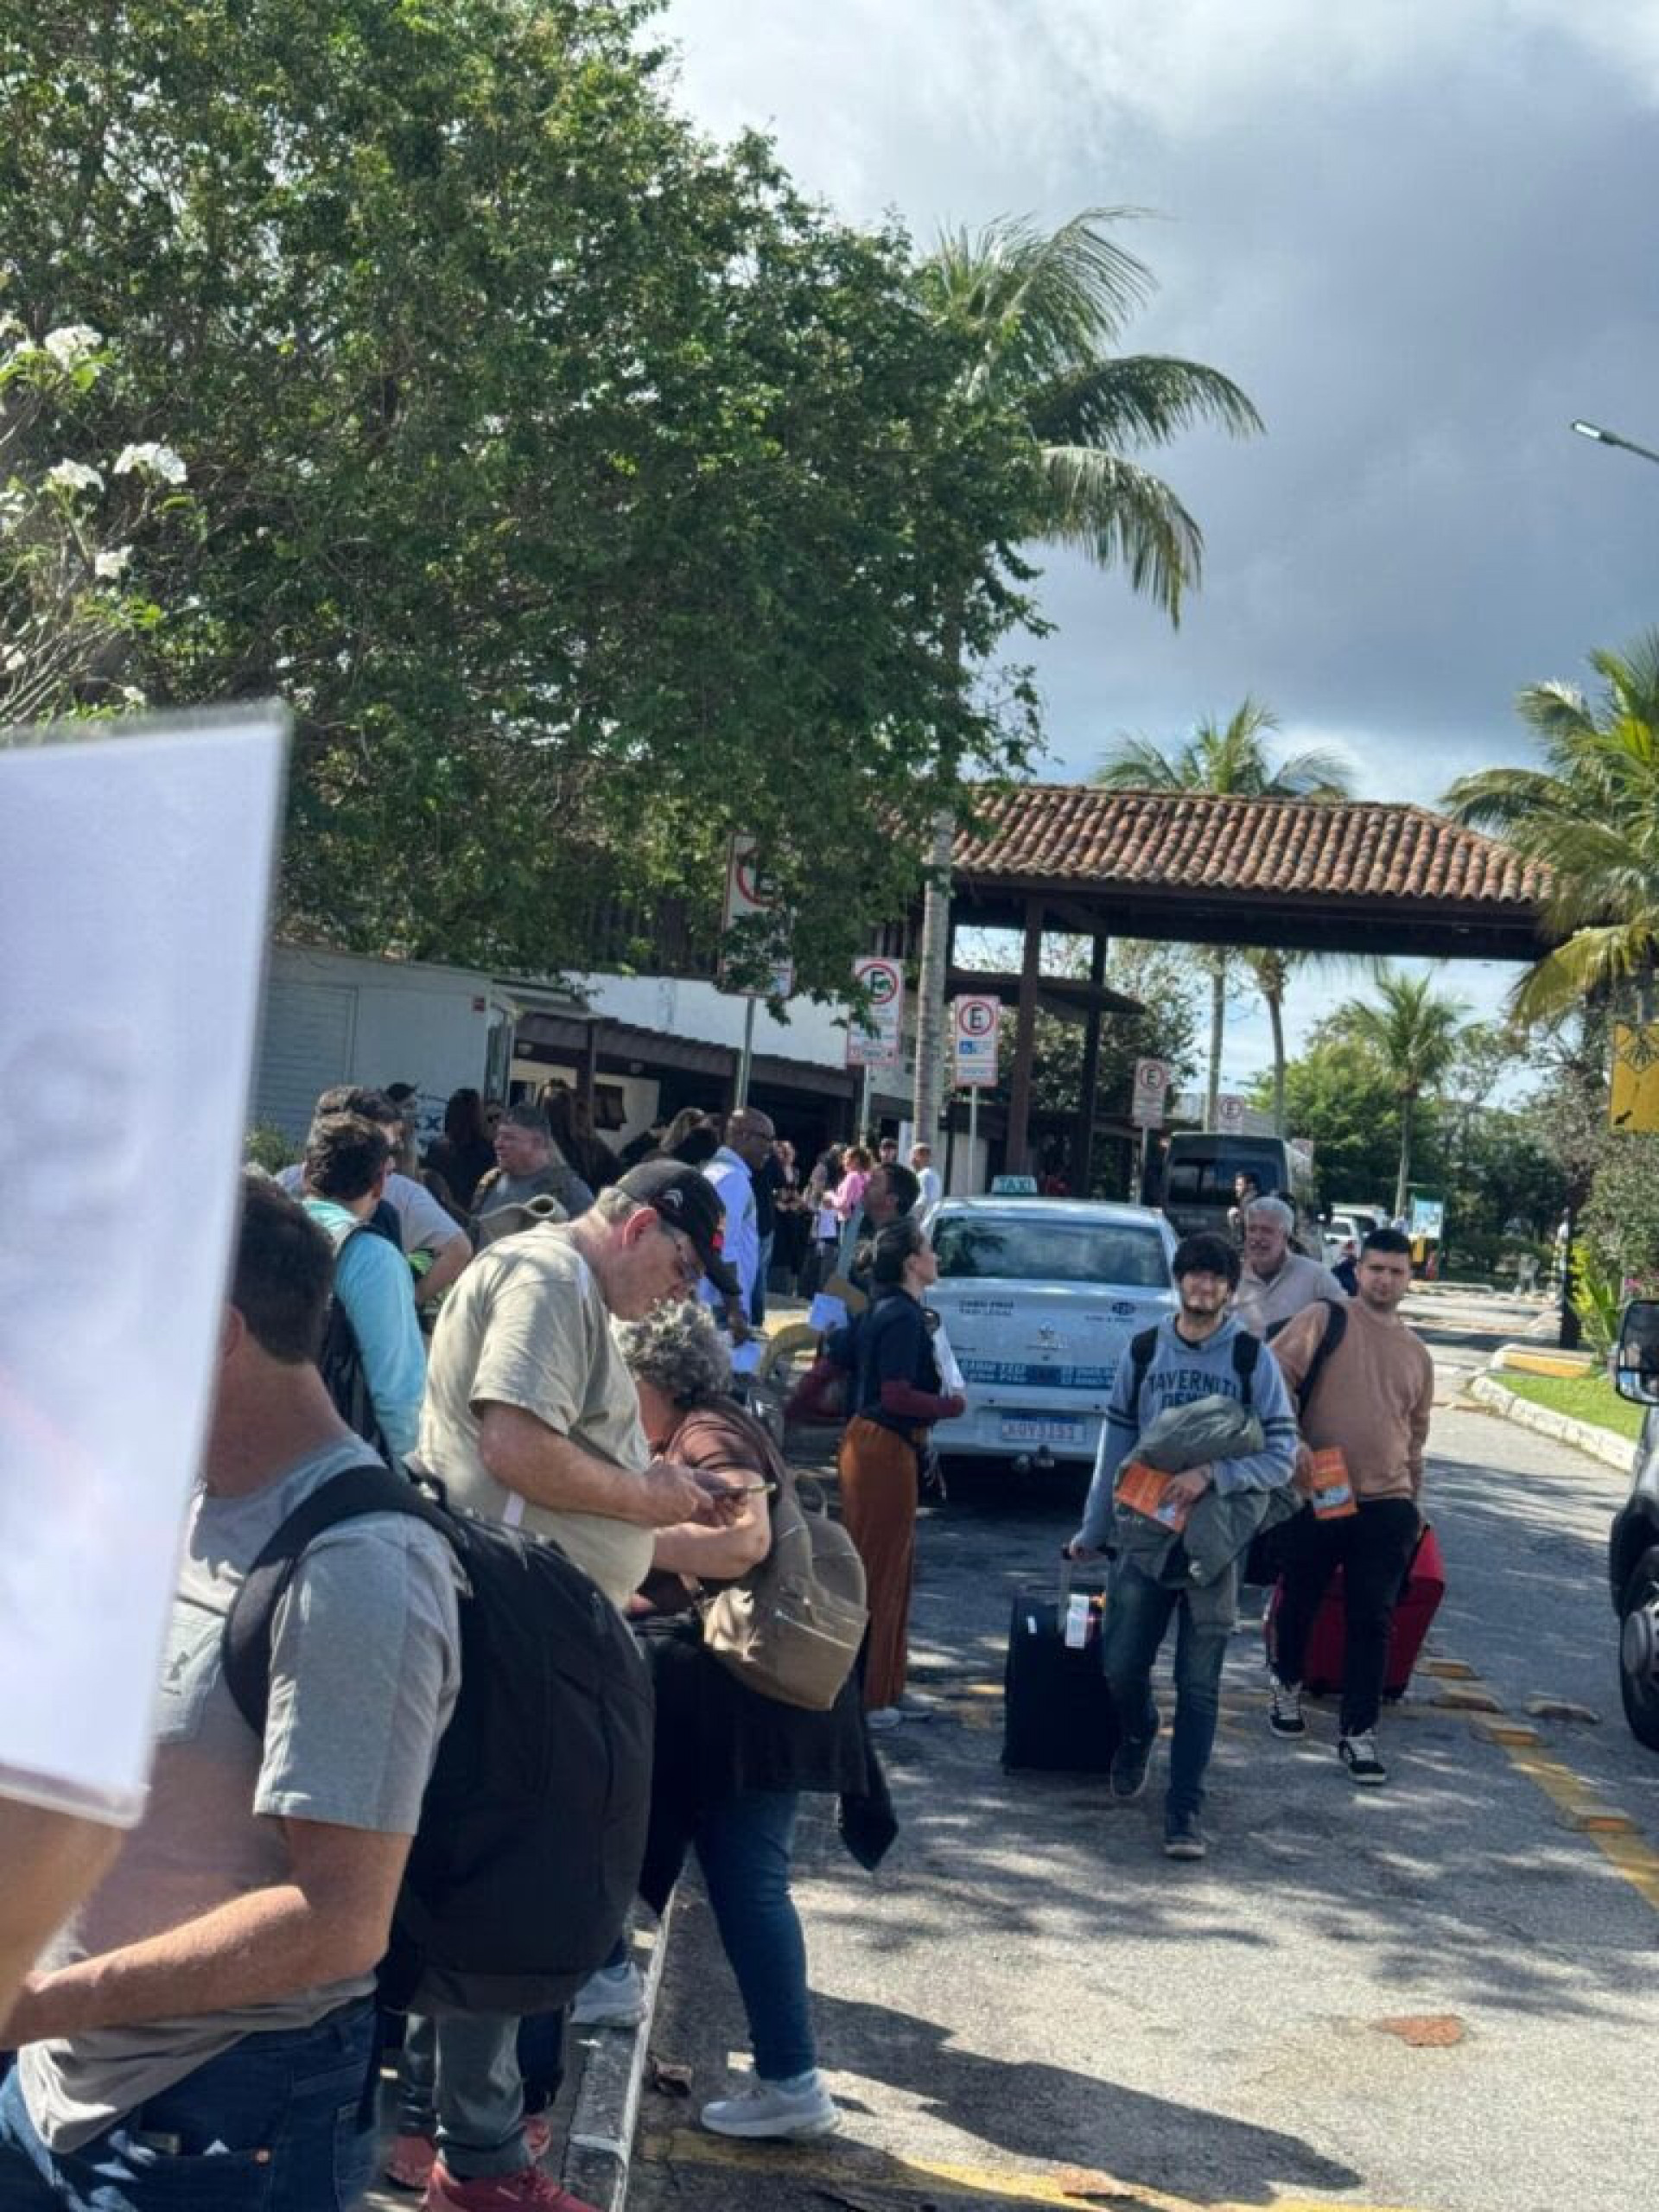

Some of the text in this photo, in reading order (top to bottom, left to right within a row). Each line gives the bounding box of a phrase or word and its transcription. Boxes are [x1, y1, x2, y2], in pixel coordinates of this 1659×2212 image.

[970, 1006, 983, 1029] E
[1147, 1069, 1157, 1085] E
[999, 1178, 1031, 1192] TAXI
